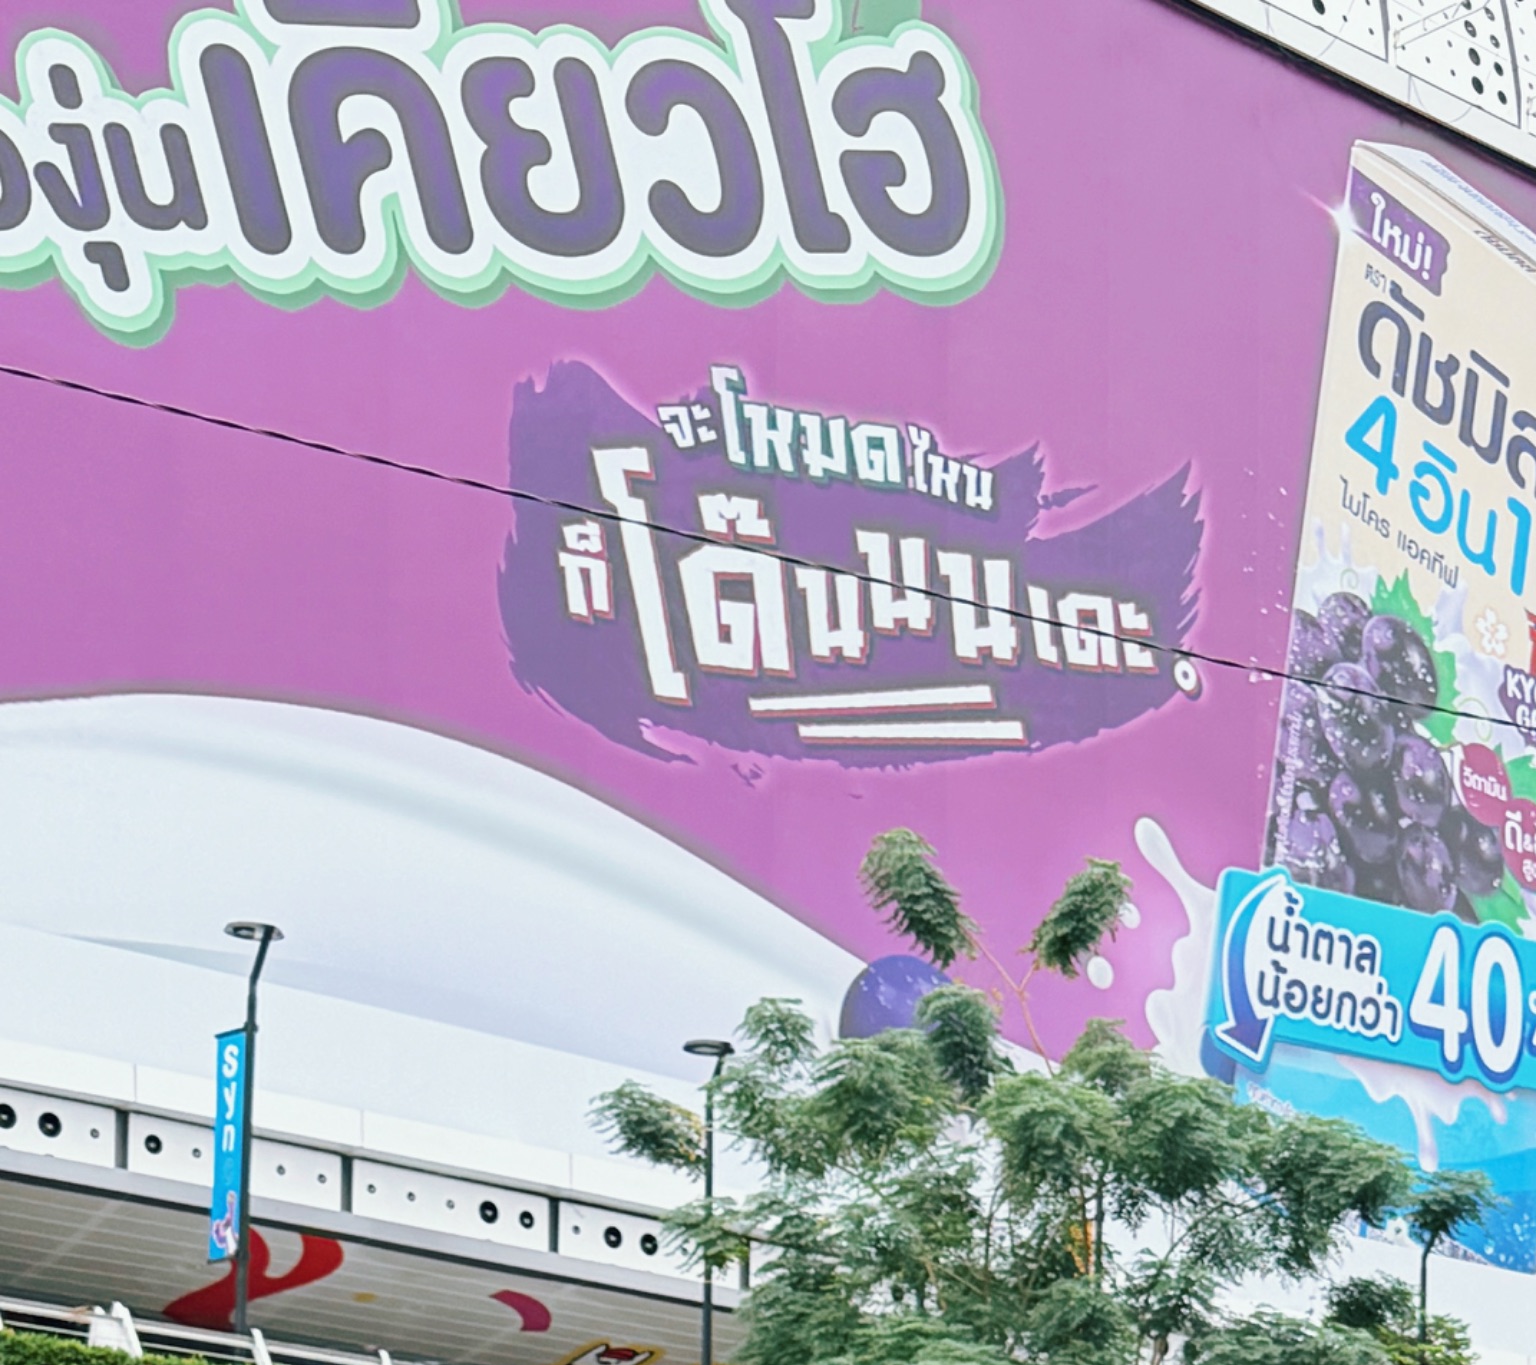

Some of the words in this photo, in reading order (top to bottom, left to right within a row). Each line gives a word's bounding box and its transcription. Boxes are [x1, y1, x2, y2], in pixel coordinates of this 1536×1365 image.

[1371, 192, 1433, 280] ใหม่!
[1338, 474, 1391, 540] ไมโคร
[1345, 395, 1399, 495] 4
[1409, 440, 1497, 576] อิน
[1507, 496, 1532, 596] 1
[1463, 766, 1508, 801] วิตามิน
[1267, 891, 1378, 975] น้ำตาล
[1257, 959, 1399, 1037] น้อยกว่า
